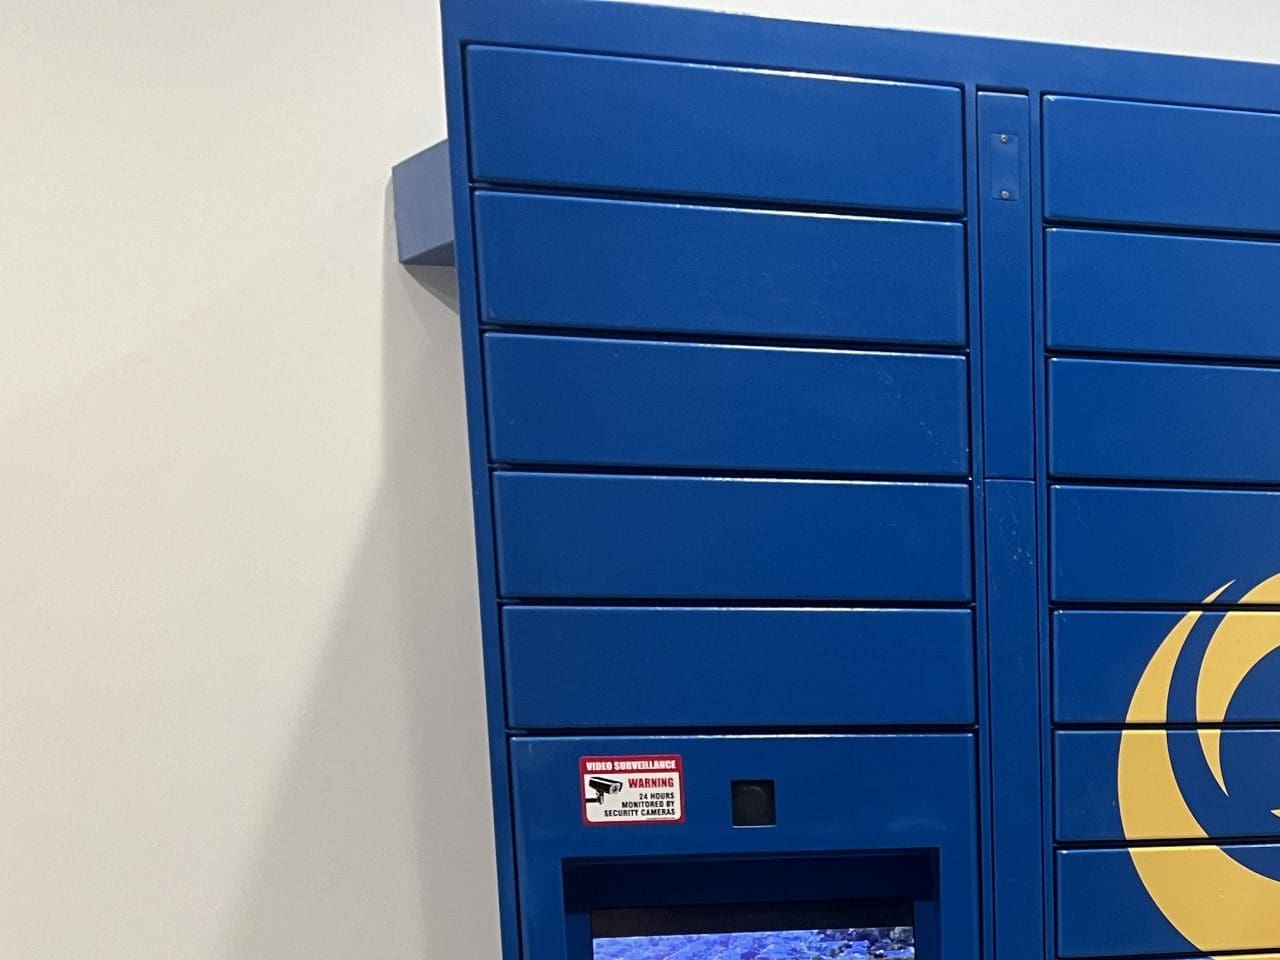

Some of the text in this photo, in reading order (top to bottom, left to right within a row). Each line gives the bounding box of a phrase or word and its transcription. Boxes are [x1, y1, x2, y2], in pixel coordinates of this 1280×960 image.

[586, 760, 676, 771] VIDEO SURVEILLANCE
[628, 778, 674, 788] WARNING
[650, 792, 675, 800] HOURS
[604, 808, 675, 817] SECURITY CAMERAS
